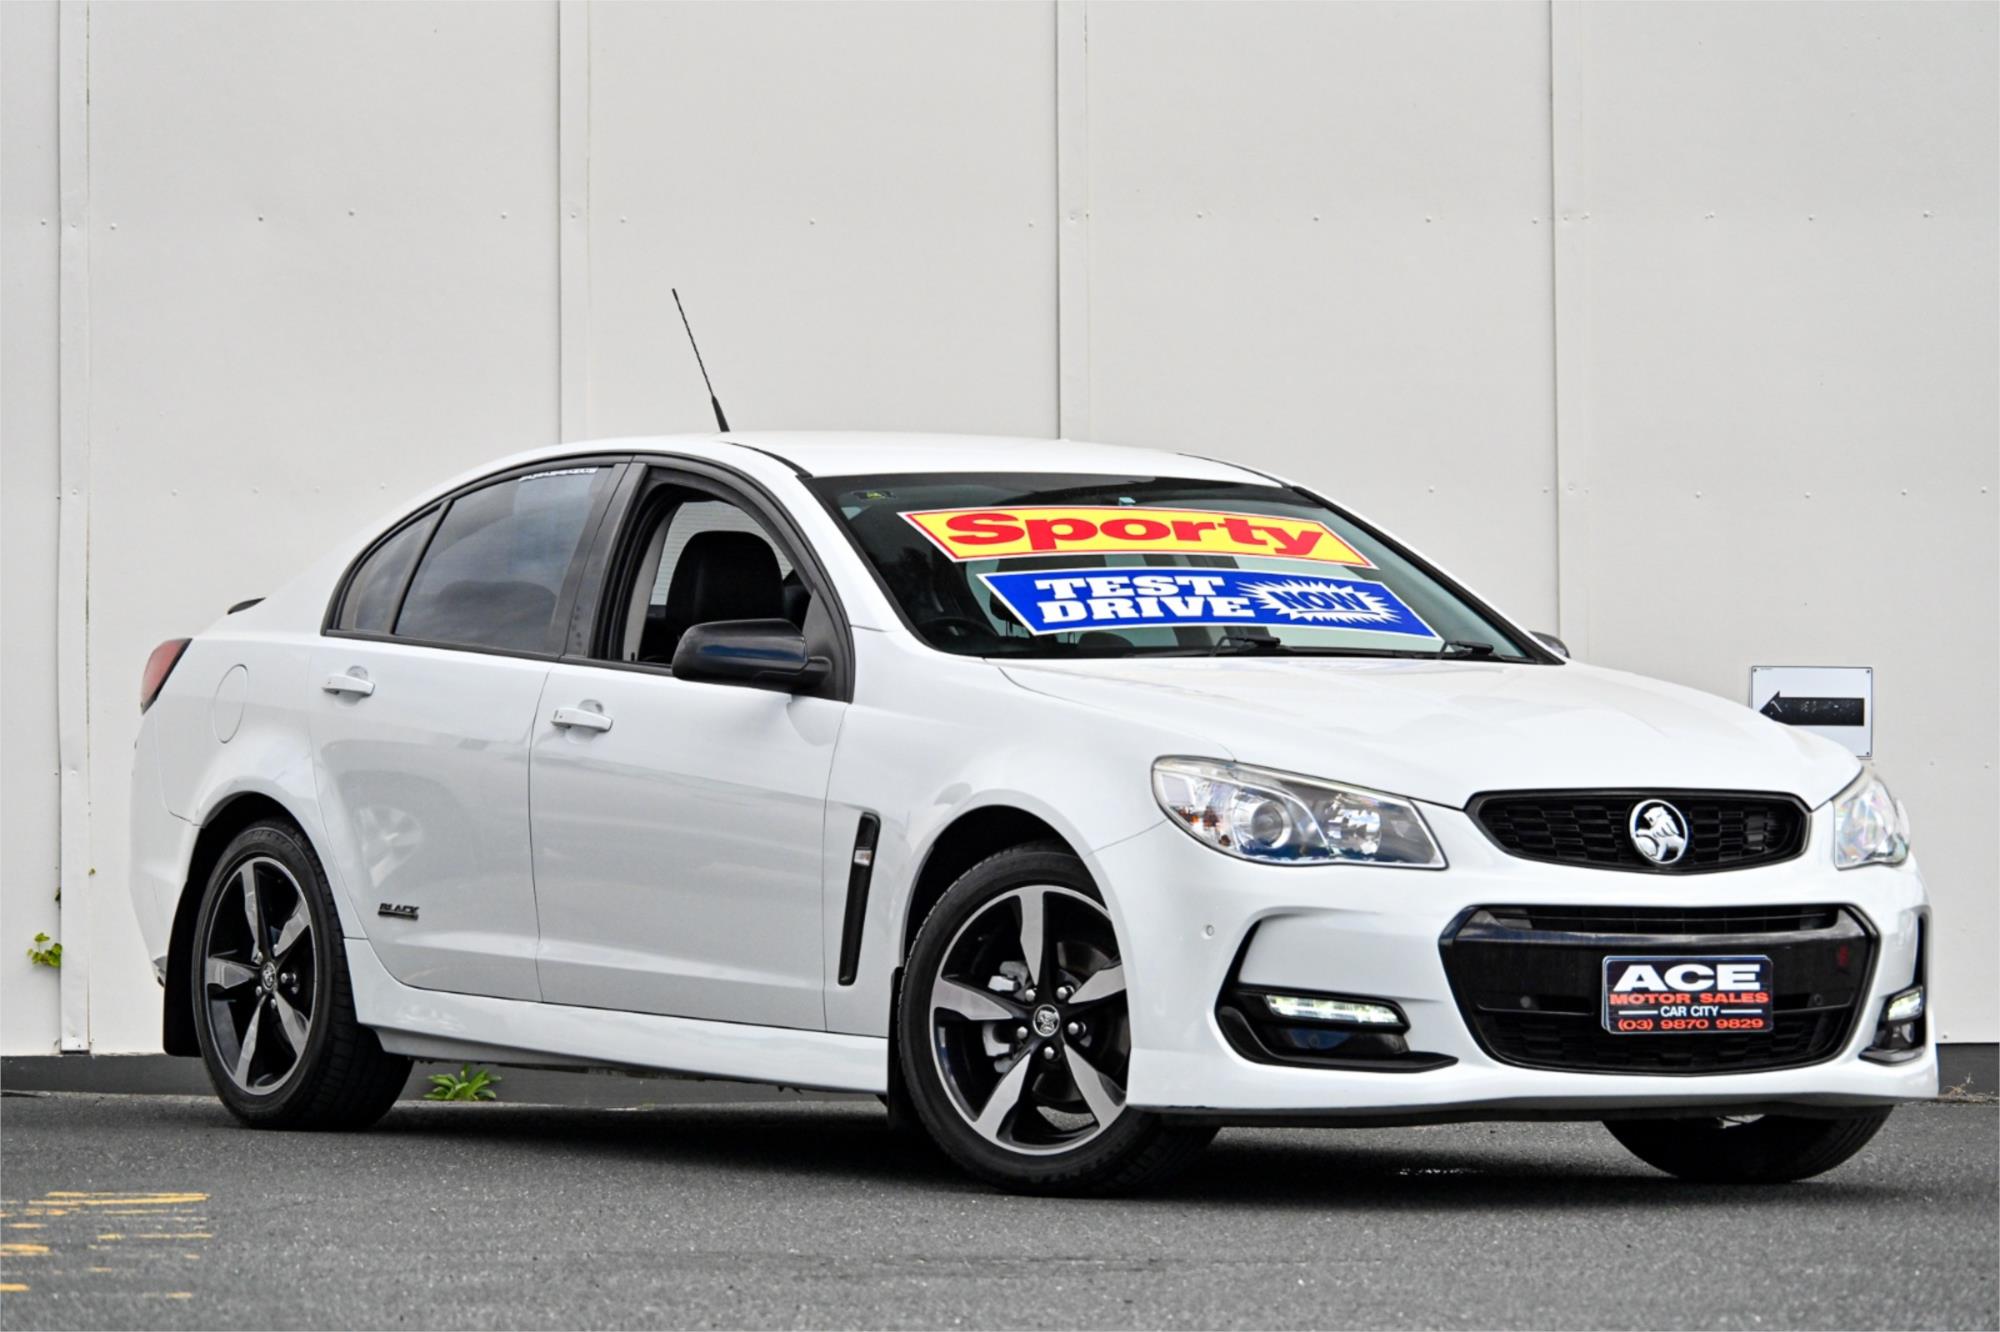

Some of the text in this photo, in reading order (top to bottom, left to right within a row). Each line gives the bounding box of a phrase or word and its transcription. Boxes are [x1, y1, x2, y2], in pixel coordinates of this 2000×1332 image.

[946, 513, 1323, 555] Sporty
[1034, 575, 1226, 599] TEST
[1036, 596, 1256, 623] DRIVE
[379, 903, 420, 913] BLACK
[1613, 964, 1760, 991] ACE
[1609, 992, 1769, 1005] MOTOR SALES
[1660, 1006, 1719, 1017] CAR CITY
[1618, 1018, 1764, 1030] (03) 9870 9829
